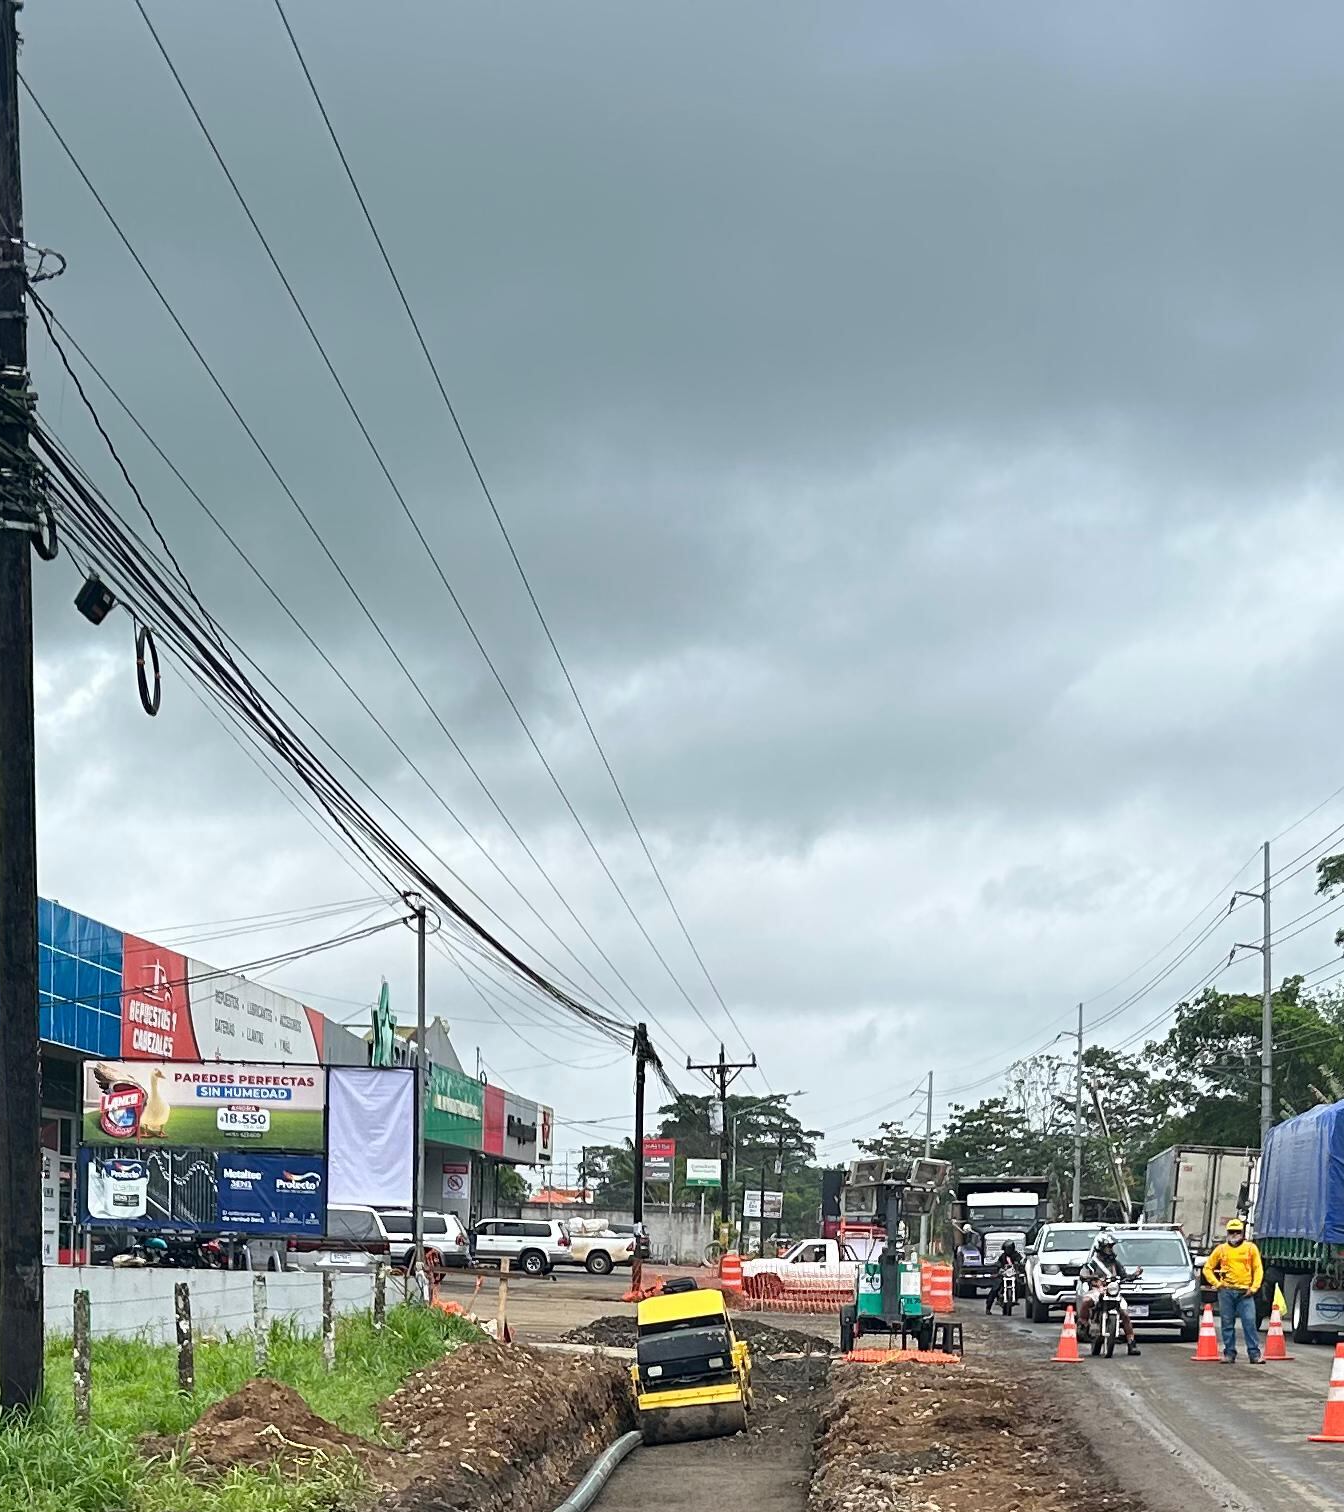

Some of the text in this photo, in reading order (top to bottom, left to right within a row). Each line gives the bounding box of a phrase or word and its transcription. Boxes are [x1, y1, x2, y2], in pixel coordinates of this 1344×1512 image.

[174, 1073, 315, 1087] PAREDES PERFECTAS
[200, 1086, 288, 1099] SIN HUMEDAD
[276, 1179, 316, 1190] Protecto
